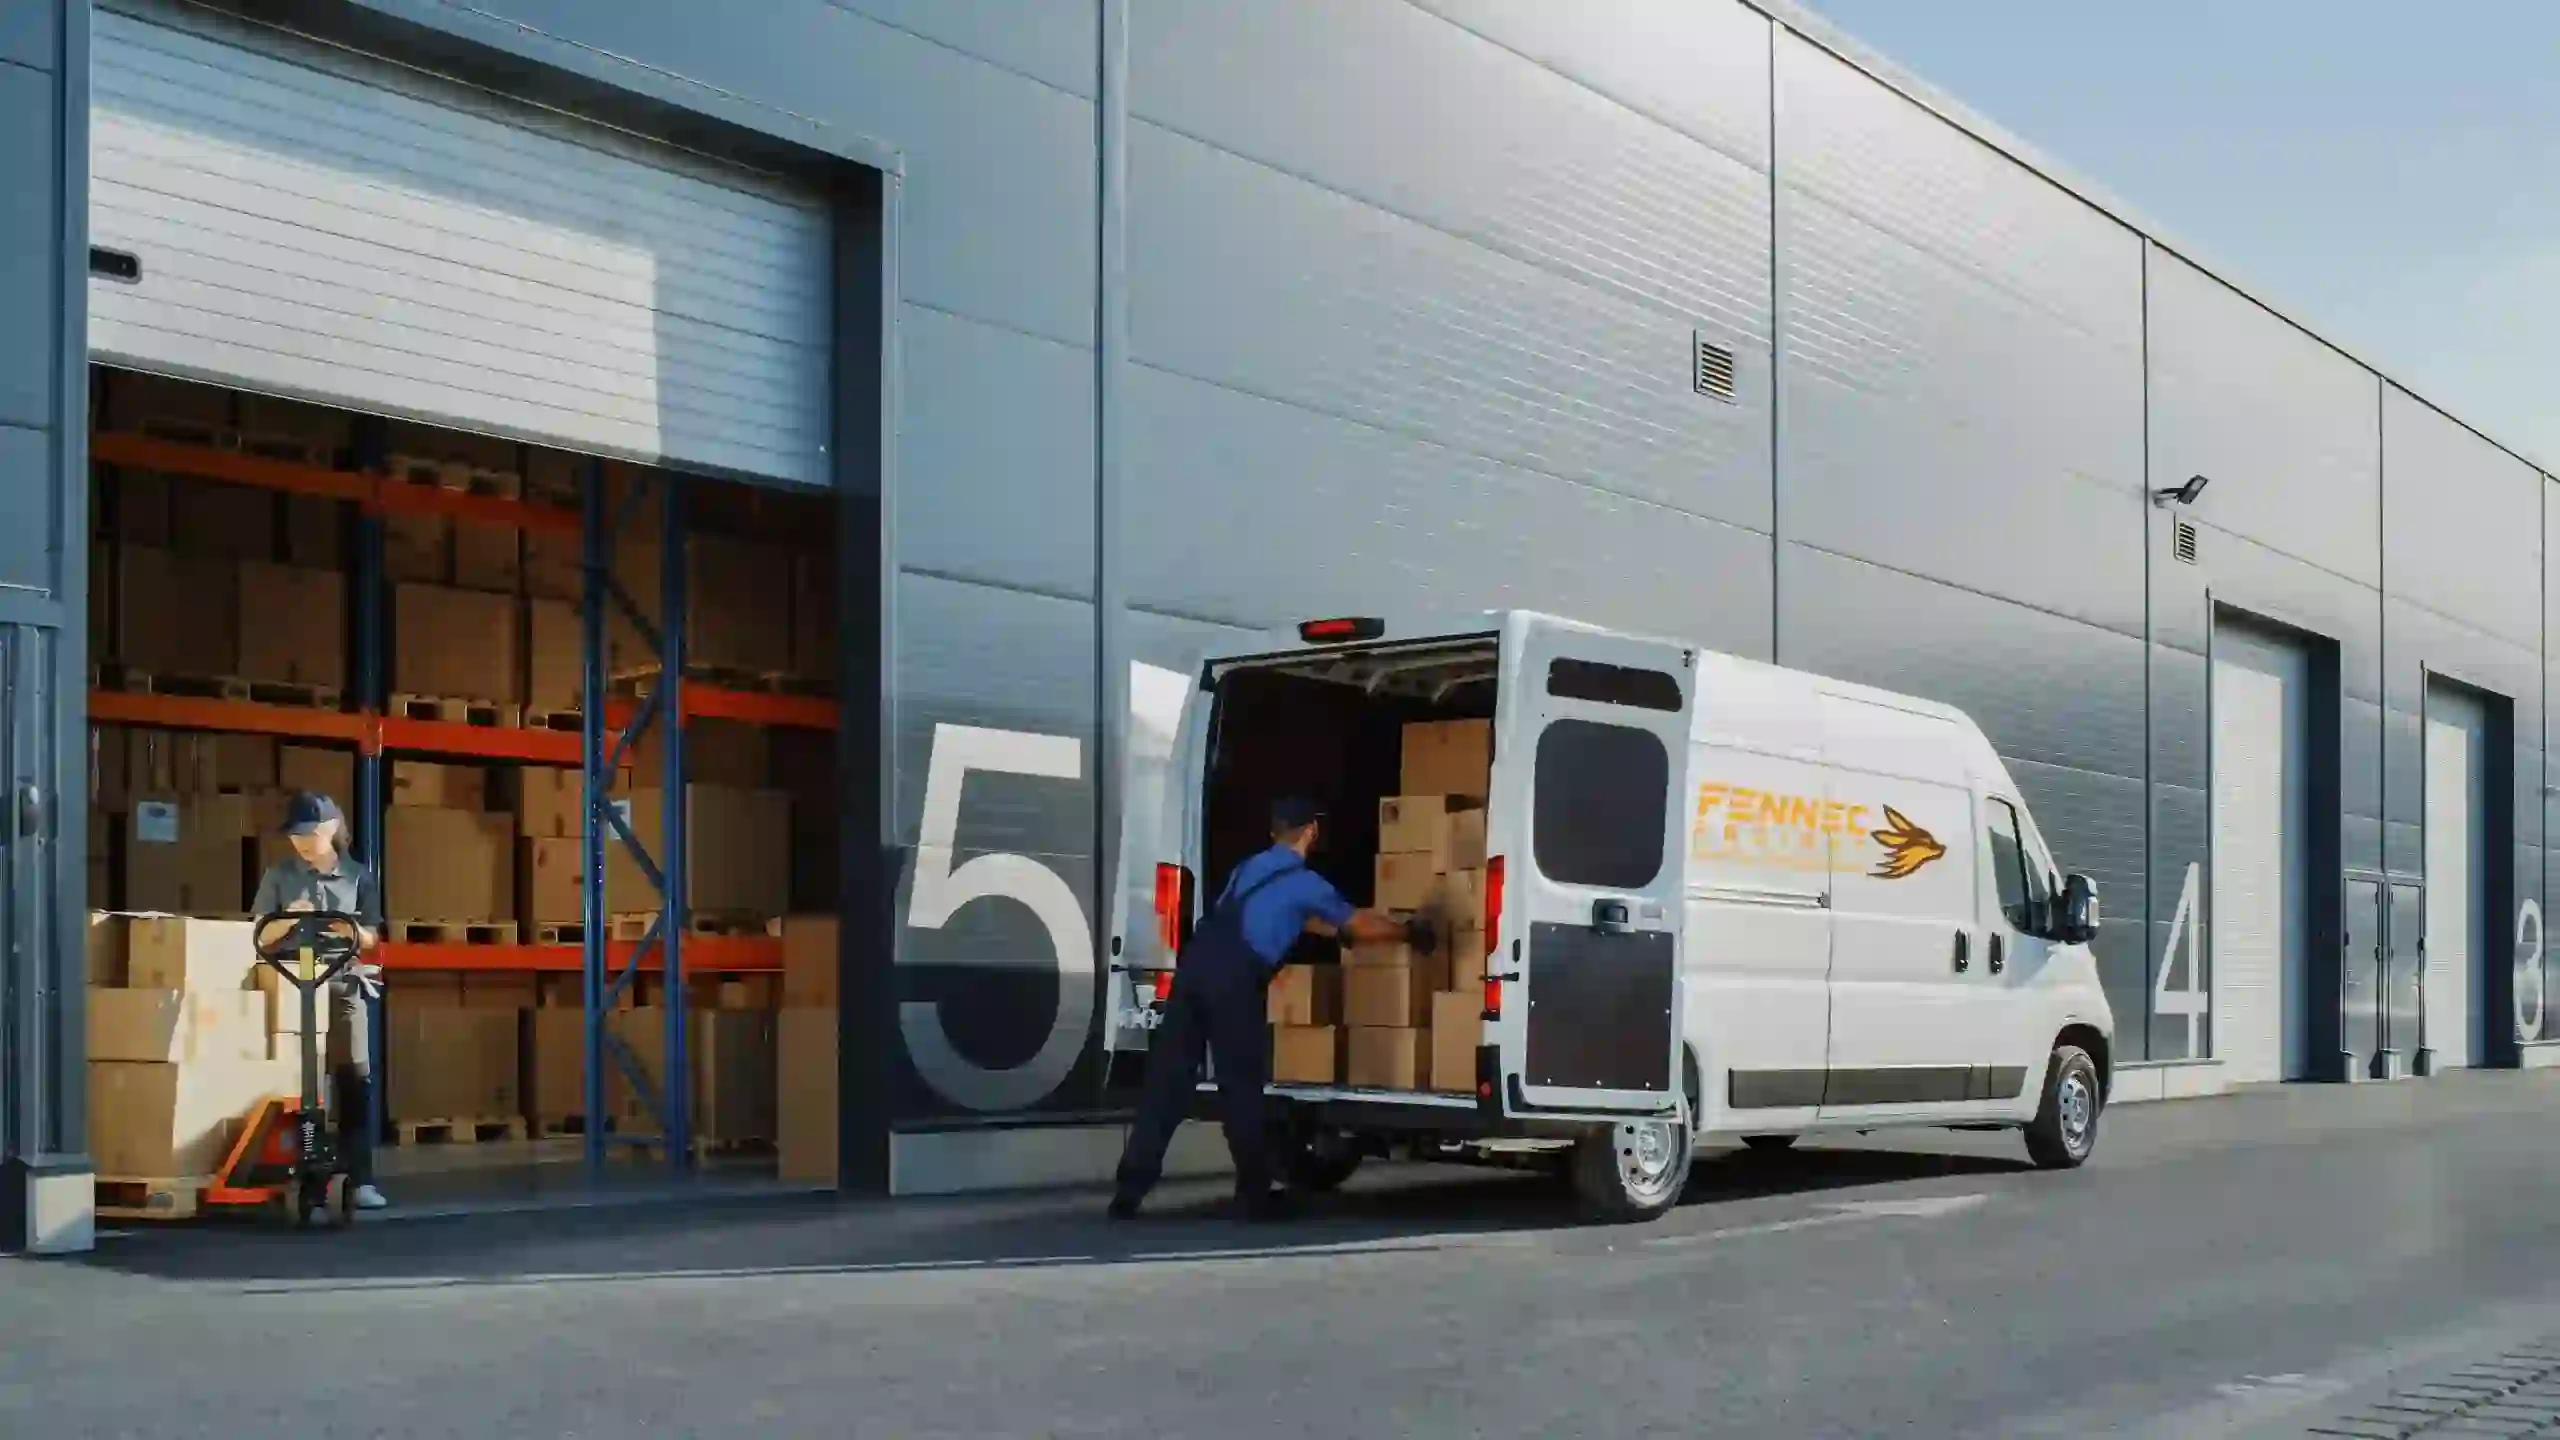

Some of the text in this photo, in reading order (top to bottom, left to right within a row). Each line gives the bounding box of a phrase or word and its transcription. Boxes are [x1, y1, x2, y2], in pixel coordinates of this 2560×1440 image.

[1698, 783, 1869, 835] FENNEC
[900, 723, 1095, 1111] 5
[2155, 862, 2208, 1058] 4
